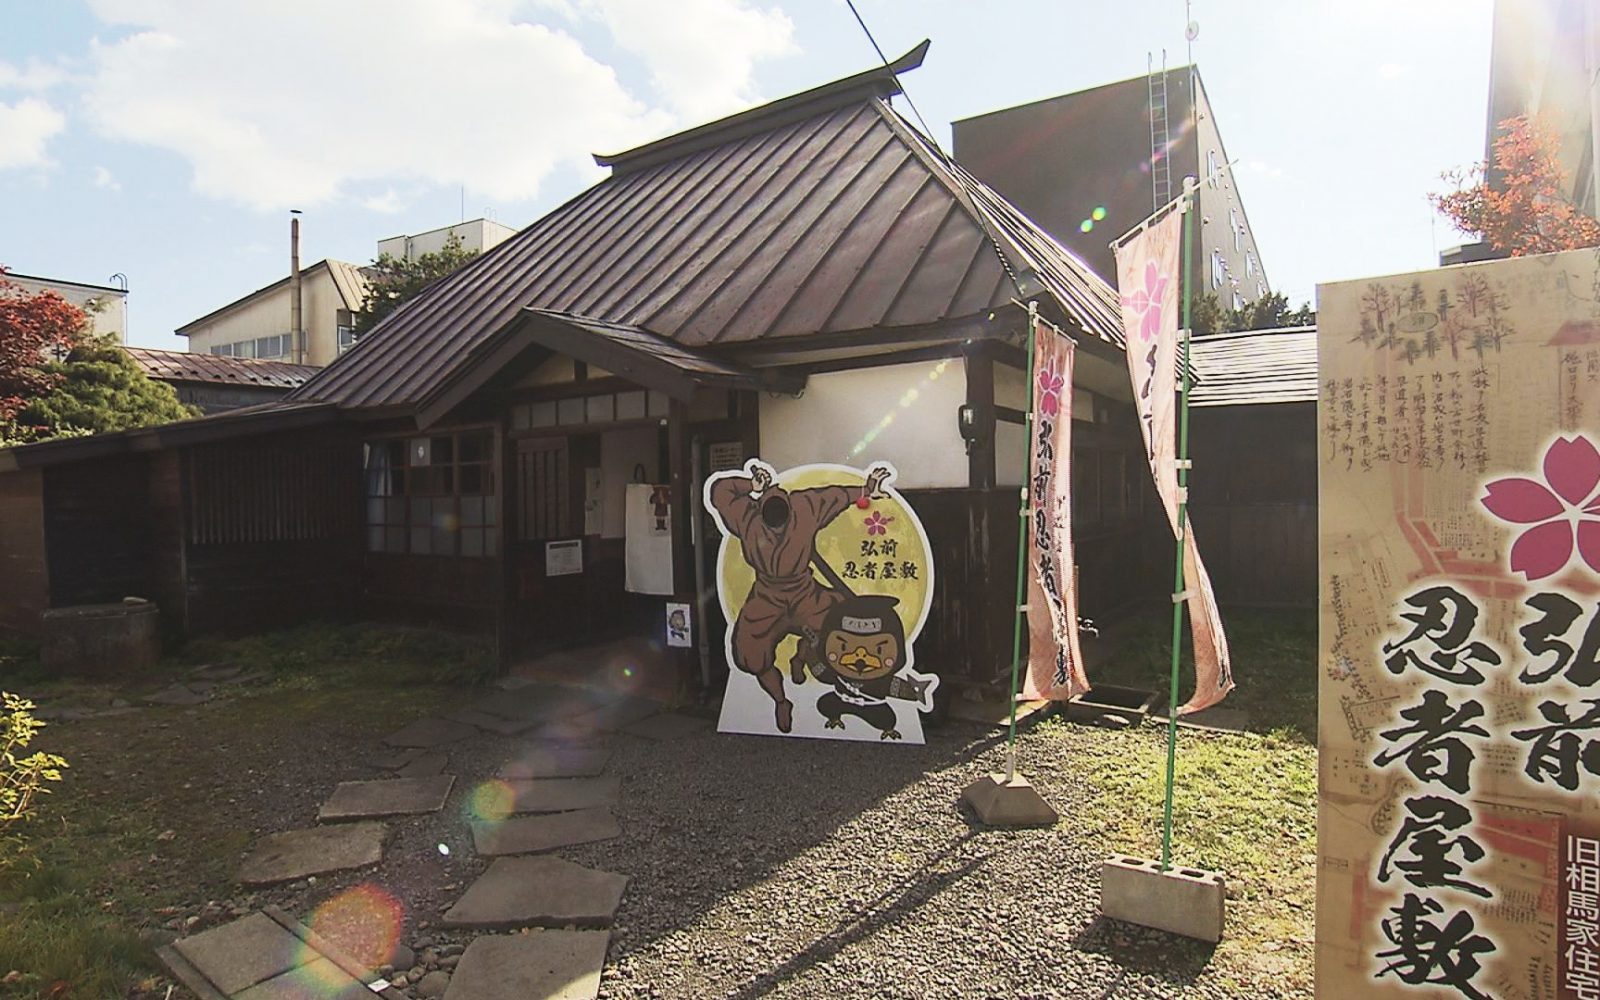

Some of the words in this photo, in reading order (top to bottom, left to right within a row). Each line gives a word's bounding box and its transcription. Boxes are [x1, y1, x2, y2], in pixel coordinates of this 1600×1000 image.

[842, 561, 918, 580] 忍者屋敷
[861, 539, 898, 558] 弘前
[1034, 420, 1069, 687] 弘前忍者敷
[1374, 586, 1501, 1000] 忍者屋敷
[1565, 835, 1600, 1000] 旧相馬家住宅
